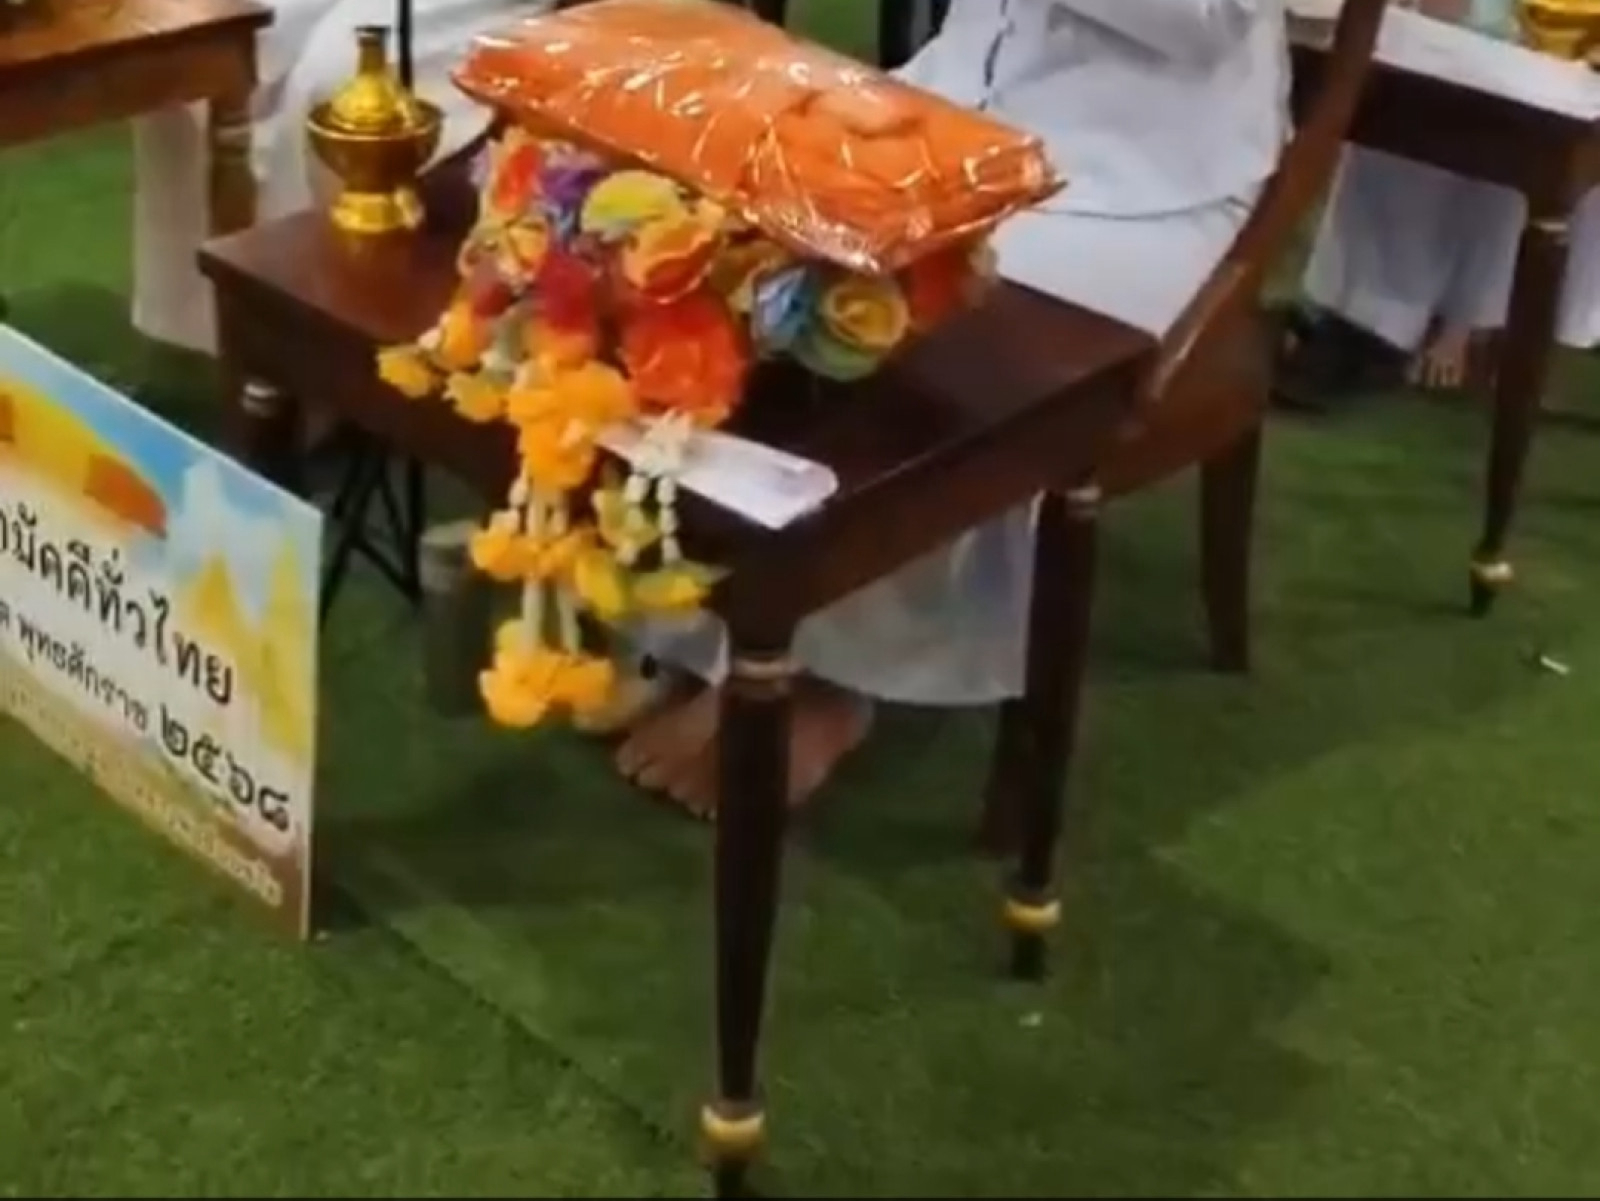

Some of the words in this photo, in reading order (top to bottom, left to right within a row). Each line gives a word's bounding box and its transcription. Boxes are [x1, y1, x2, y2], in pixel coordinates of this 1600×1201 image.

[18, 613, 148, 731] พุทธศักราช
[160, 702, 290, 832] ๒๕๖๘
